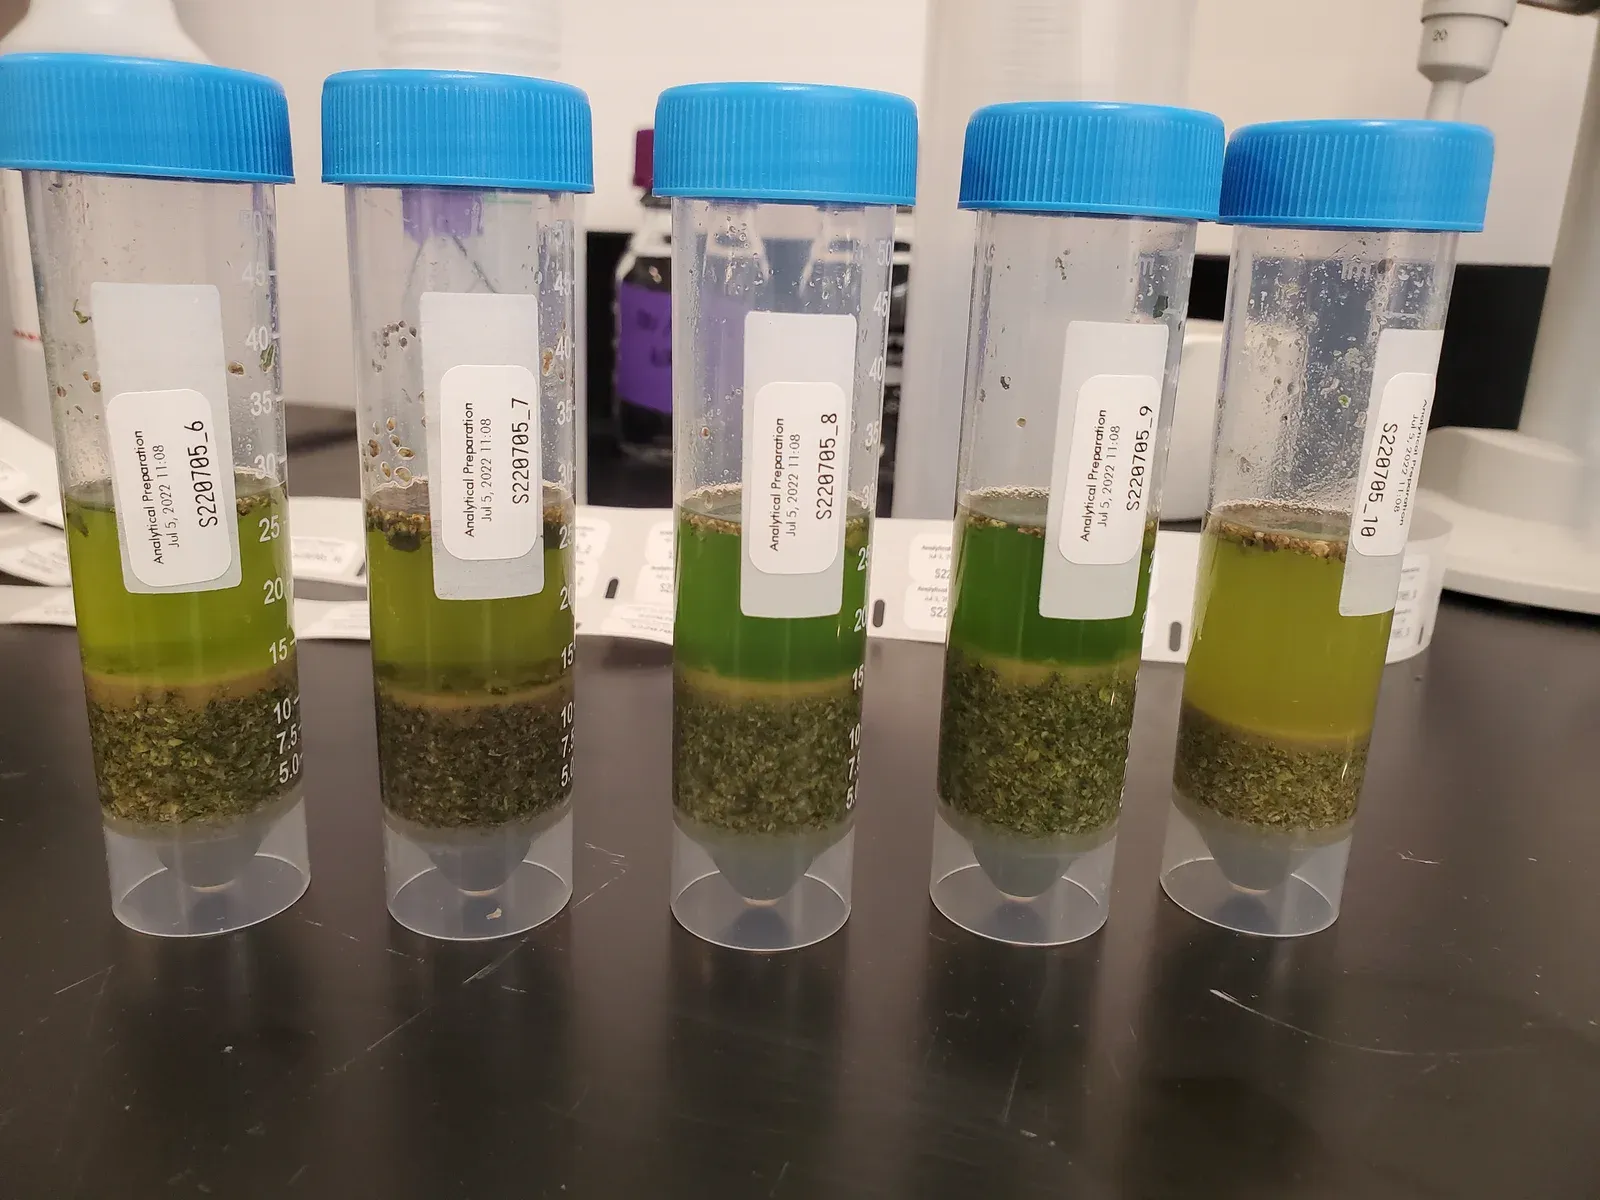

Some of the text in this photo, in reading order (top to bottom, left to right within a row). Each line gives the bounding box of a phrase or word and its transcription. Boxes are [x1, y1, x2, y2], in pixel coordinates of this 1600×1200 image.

[876, 239, 892, 266] 50
[242, 261, 265, 287] 45
[873, 291, 889, 318] 45
[245, 325, 269, 351] 40
[554, 336, 571, 361] 40
[869, 356, 883, 382] 40
[250, 391, 272, 416] 35
[557, 400, 573, 425] 35
[480, 418, 492, 451] 11:08
[865, 420, 879, 447] 35
[1106, 425, 1120, 459] 11:08
[152, 444, 168, 478] 11:08
[511, 397, 531, 504] S220705_7
[788, 434, 800, 467] 11:08
[1126, 405, 1153, 511] S220705_9
[184, 420, 218, 528] S220705_6
[254, 453, 276, 479] 30
[462, 402, 477, 538] Analytical Preparation
[481, 458, 492, 488] 2022
[558, 461, 573, 486] 30
[816, 413, 838, 520] S220705_8
[1080, 409, 1107, 542] Analytical Preparation
[1102, 464, 1115, 494] 2022
[1360, 422, 1398, 537] S220705_10
[134, 430, 164, 565] Analytical Preparation
[769, 418, 785, 551] Analytical Preparation
[787, 473, 798, 504] 2022
[159, 484, 174, 514] 2022
[481, 506, 492, 522] Jul
[1097, 512, 1108, 527] Jul
[166, 533, 180, 548] Jul
[259, 515, 280, 542] 25
[786, 521, 796, 537] Jul
[263, 577, 283, 604] 20
[854, 608, 867, 633] 20
[268, 637, 288, 664] 15
[561, 642, 574, 669] 15
[852, 664, 864, 691] 15
[273, 697, 292, 724] 10
[561, 701, 573, 729] 10
[276, 723, 298, 754] 7.5
[849, 723, 860, 750] 10
[279, 752, 300, 783] 5.0
